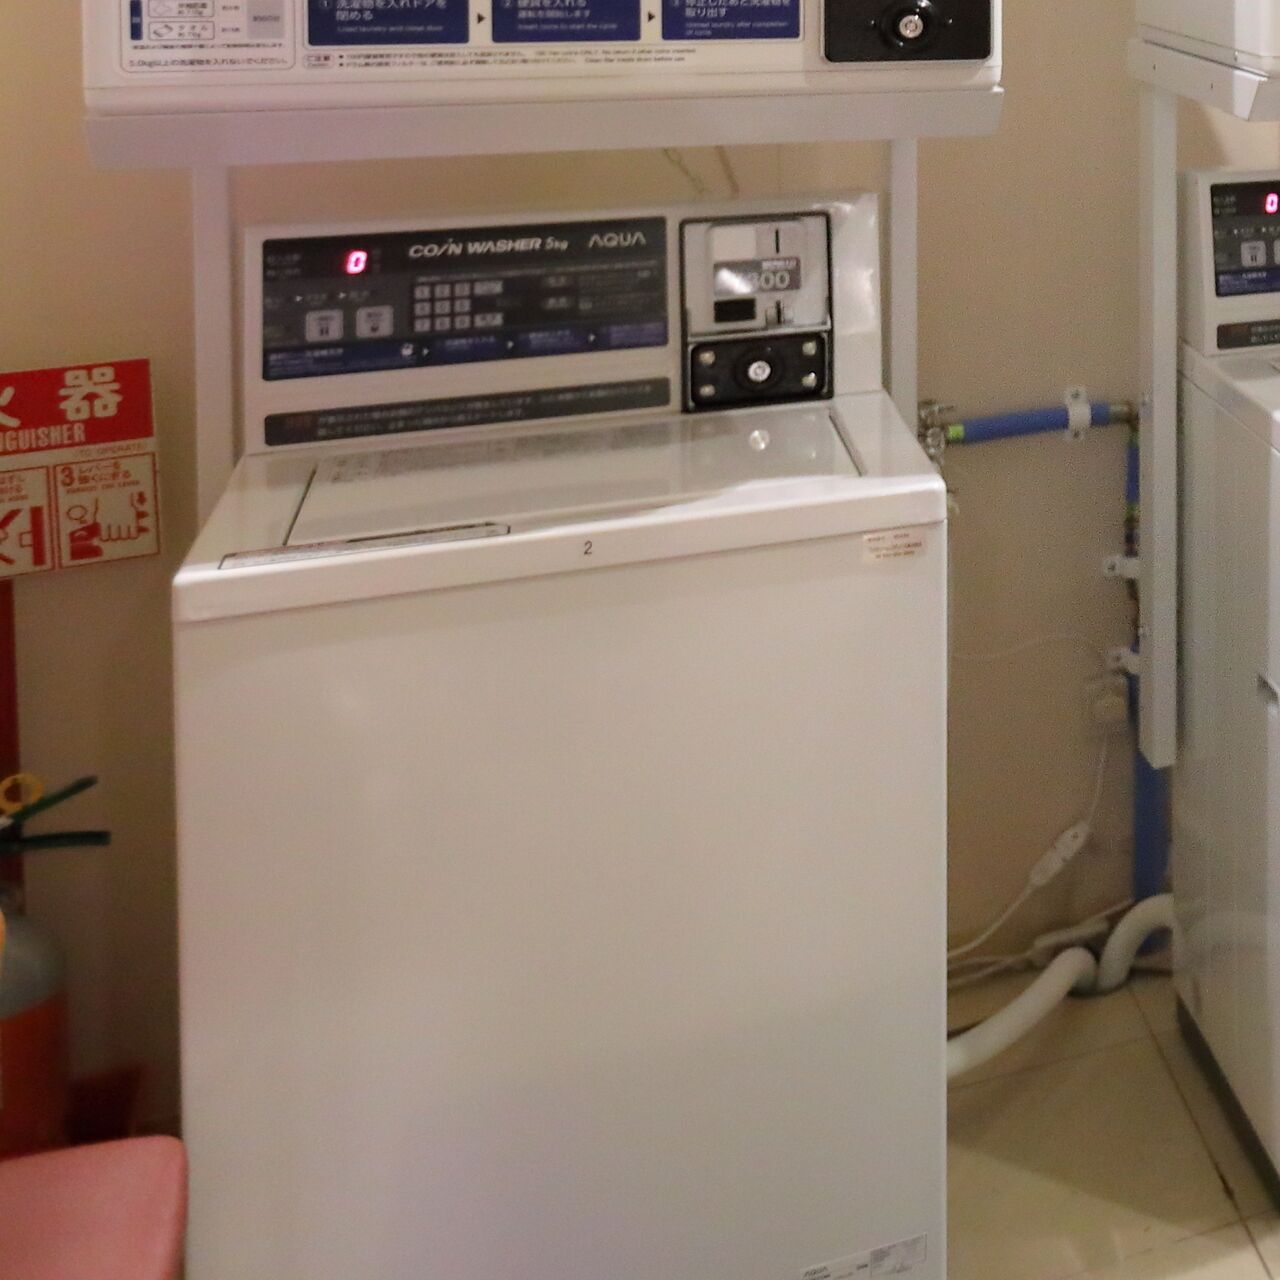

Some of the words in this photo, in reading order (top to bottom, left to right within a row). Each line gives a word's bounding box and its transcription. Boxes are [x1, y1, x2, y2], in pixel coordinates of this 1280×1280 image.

[1264, 192, 1279, 214] 0
[465, 237, 542, 256] WASHER
[588, 231, 647, 249] AQUA
[345, 249, 369, 275] 0
[61, 466, 75, 487] 3
[583, 540, 593, 556] 2
